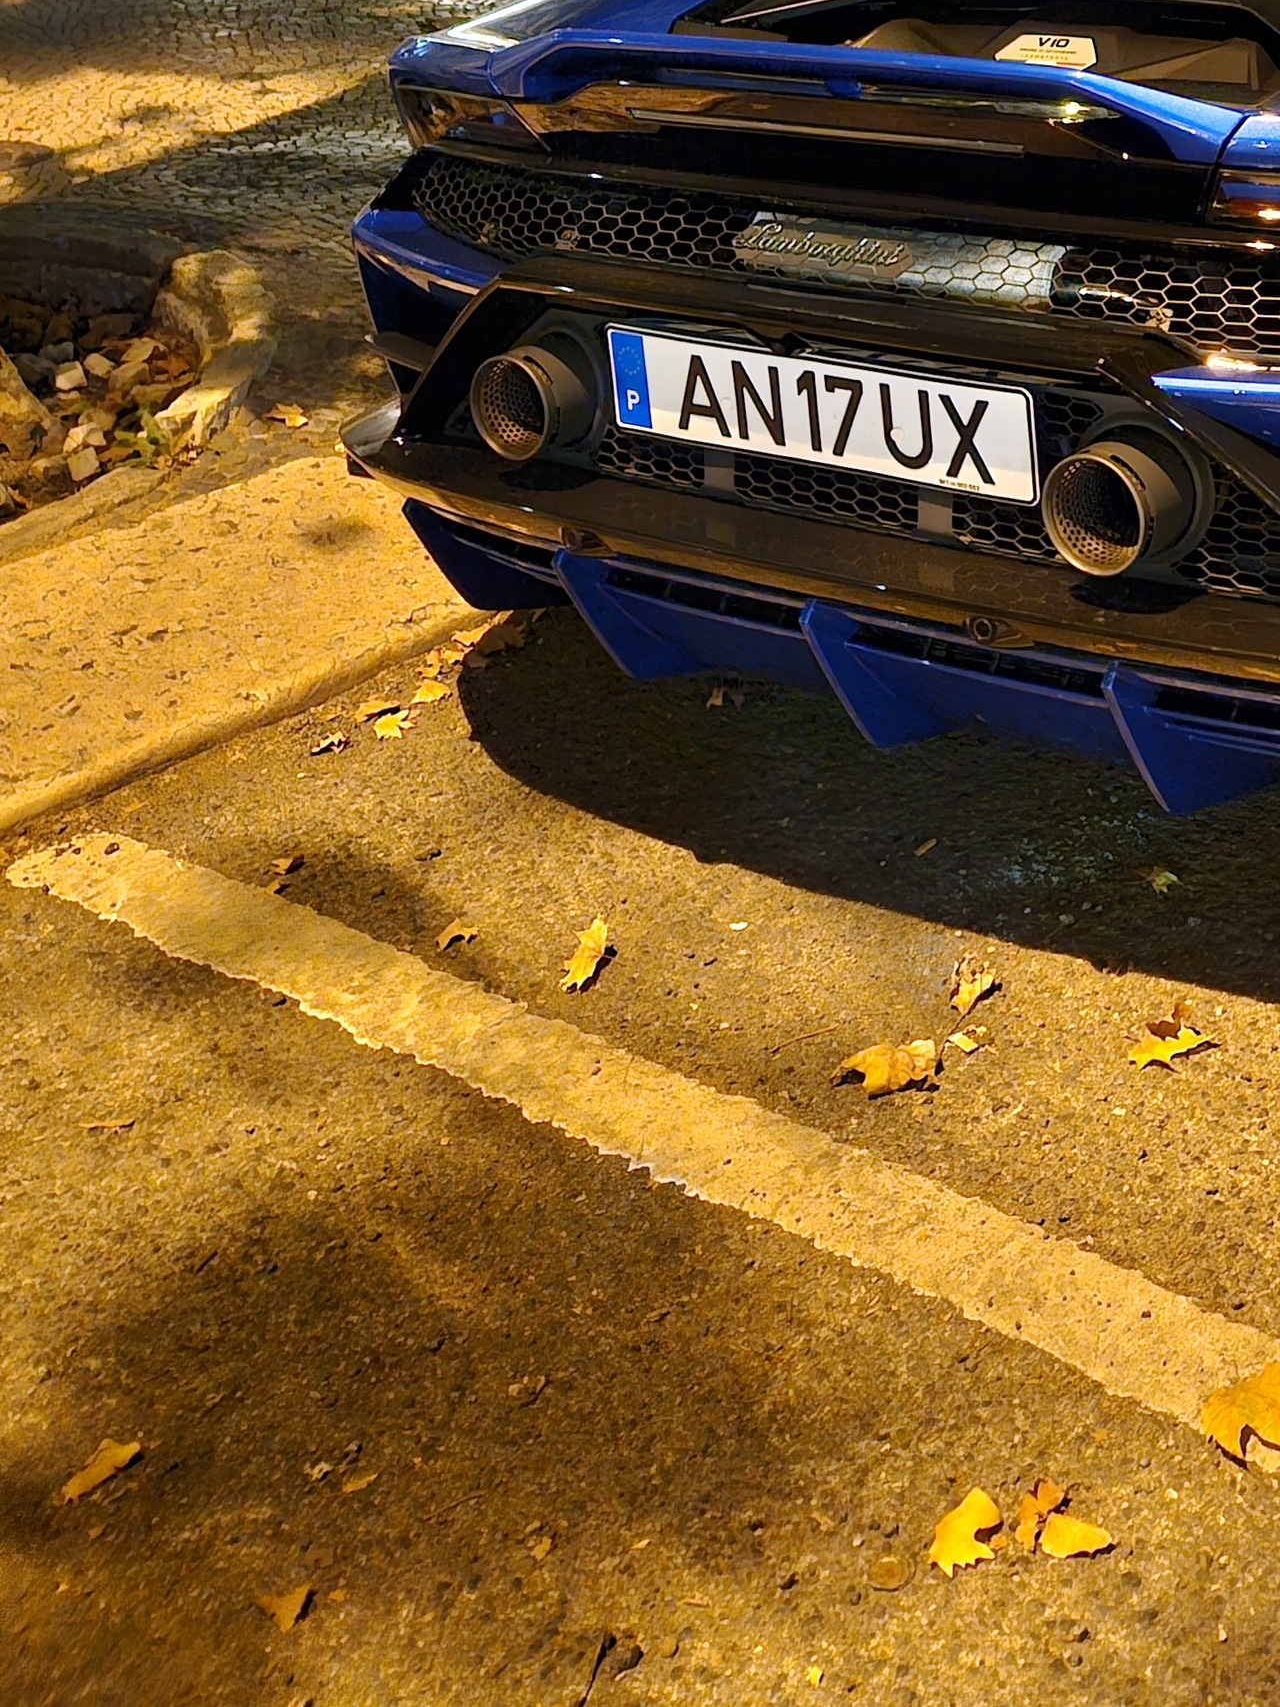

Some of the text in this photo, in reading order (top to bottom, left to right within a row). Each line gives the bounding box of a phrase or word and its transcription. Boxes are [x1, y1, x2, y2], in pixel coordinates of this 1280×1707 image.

[1038, 37, 1070, 48] V10
[731, 221, 906, 267] Lamborghini
[625, 388, 641, 412] P
